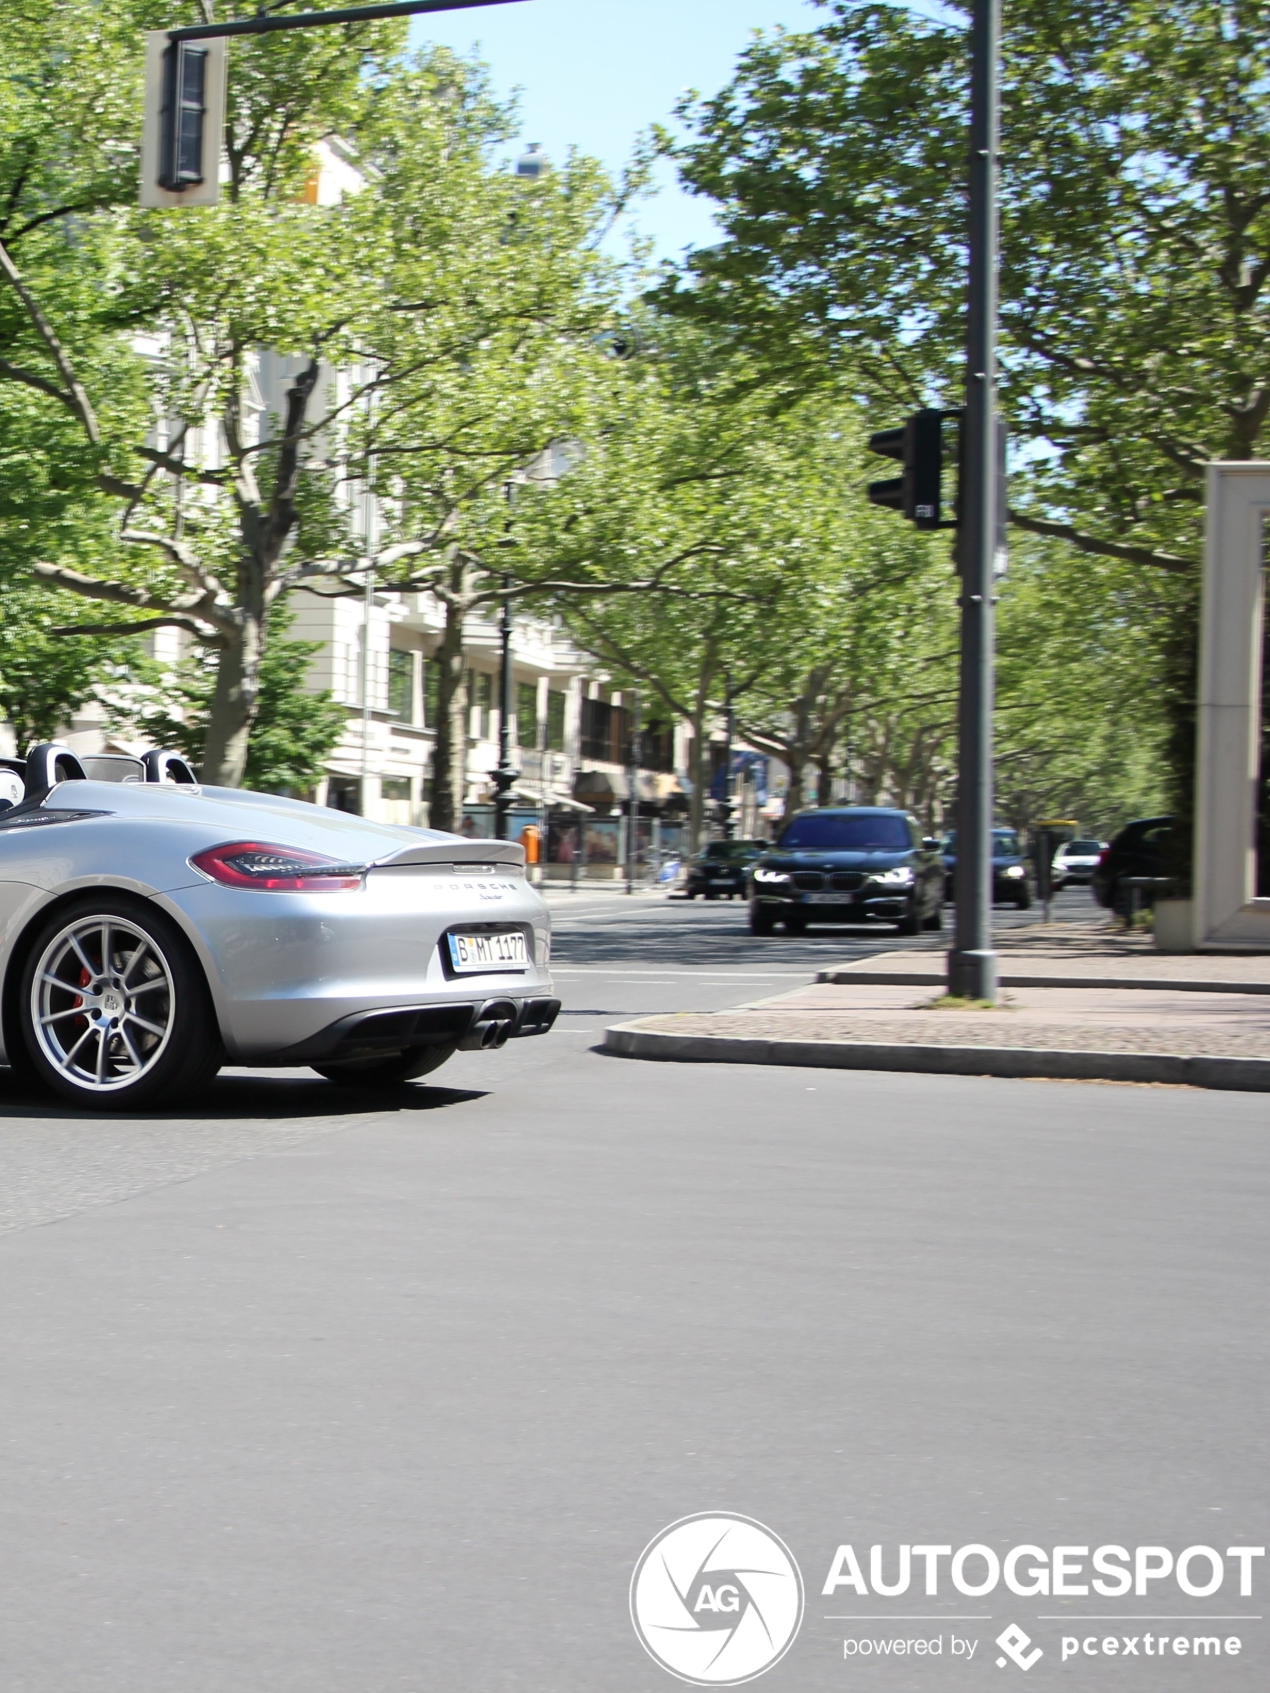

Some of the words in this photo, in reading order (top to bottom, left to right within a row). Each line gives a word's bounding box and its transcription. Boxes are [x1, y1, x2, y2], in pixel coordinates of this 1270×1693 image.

[433, 883, 518, 891] PORSCHE
[458, 938, 469, 962] B
[475, 936, 493, 961] MT
[496, 936, 524, 961] 1177
